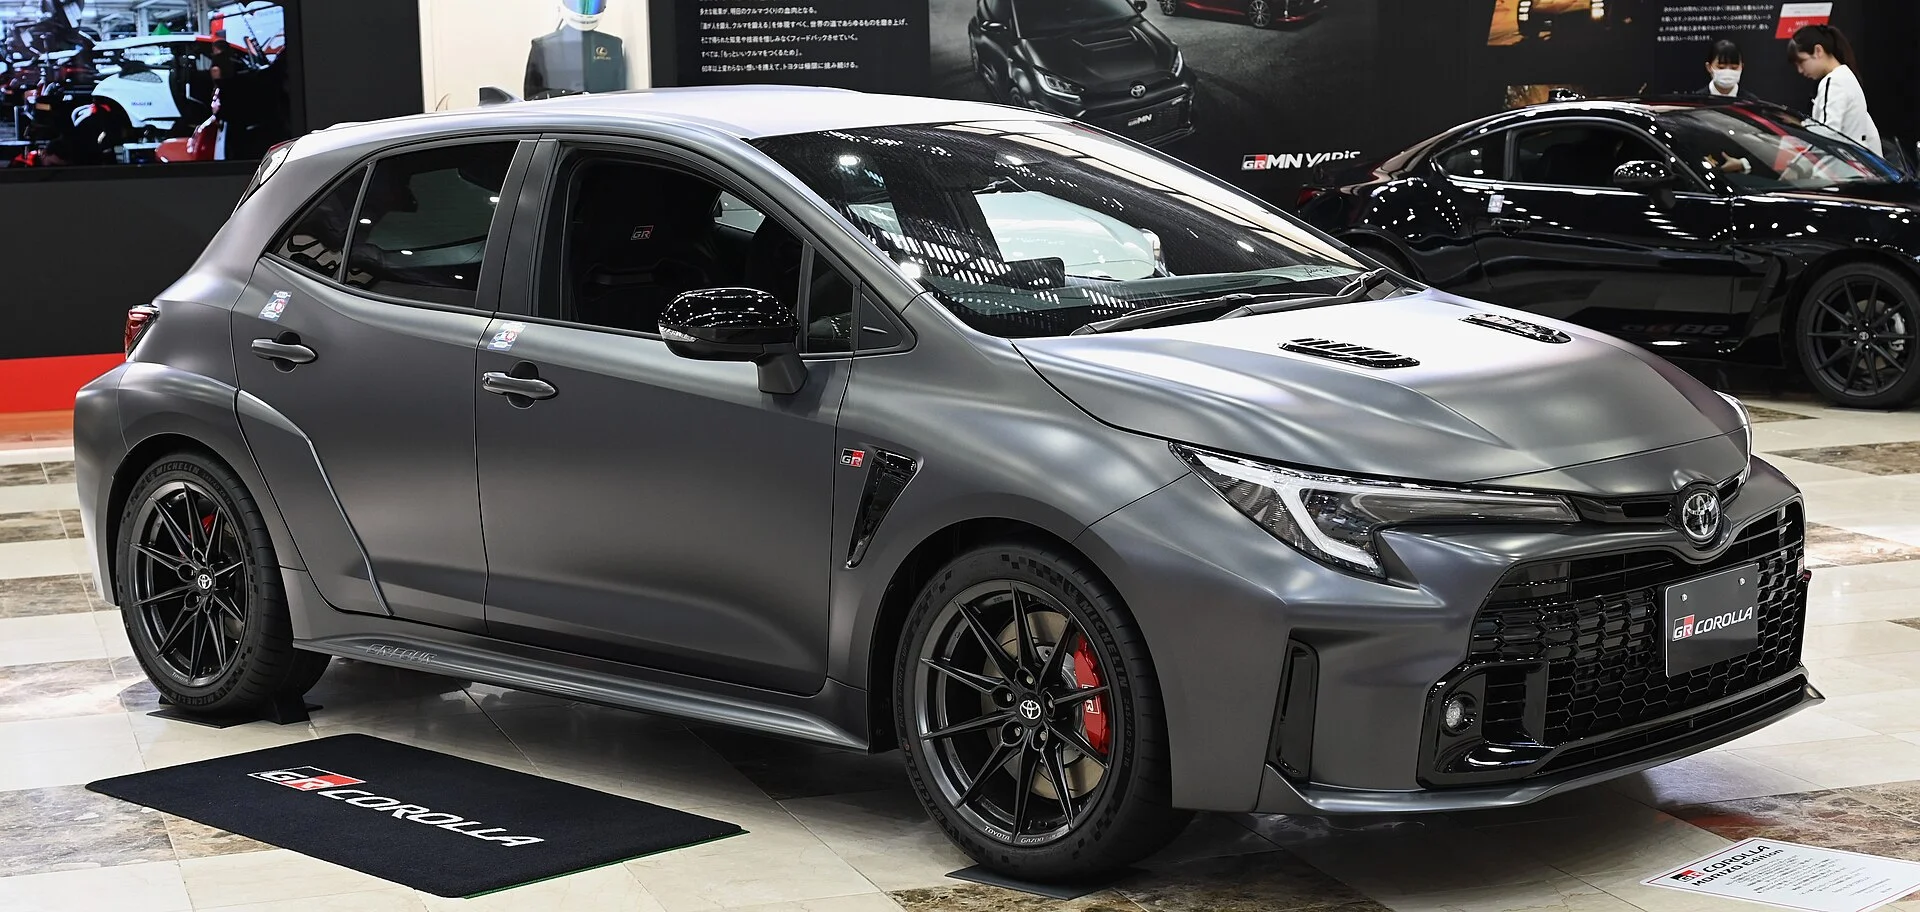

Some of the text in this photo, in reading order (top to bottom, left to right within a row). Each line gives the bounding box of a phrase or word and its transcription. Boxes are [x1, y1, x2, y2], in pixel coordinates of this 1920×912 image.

[631, 229, 652, 240] GR
[155, 462, 201, 475] MICHELIN
[841, 453, 864, 467] GR
[1673, 606, 1753, 640] GR COROLLA
[1078, 600, 1129, 688] MICHELIN
[318, 789, 545, 847] COROLLA
[984, 825, 1011, 841] TOYOTA
[1691, 865, 1744, 886] MORIZO
[1741, 849, 1784, 866] Edition
[1702, 845, 1770, 873] COROLLA
